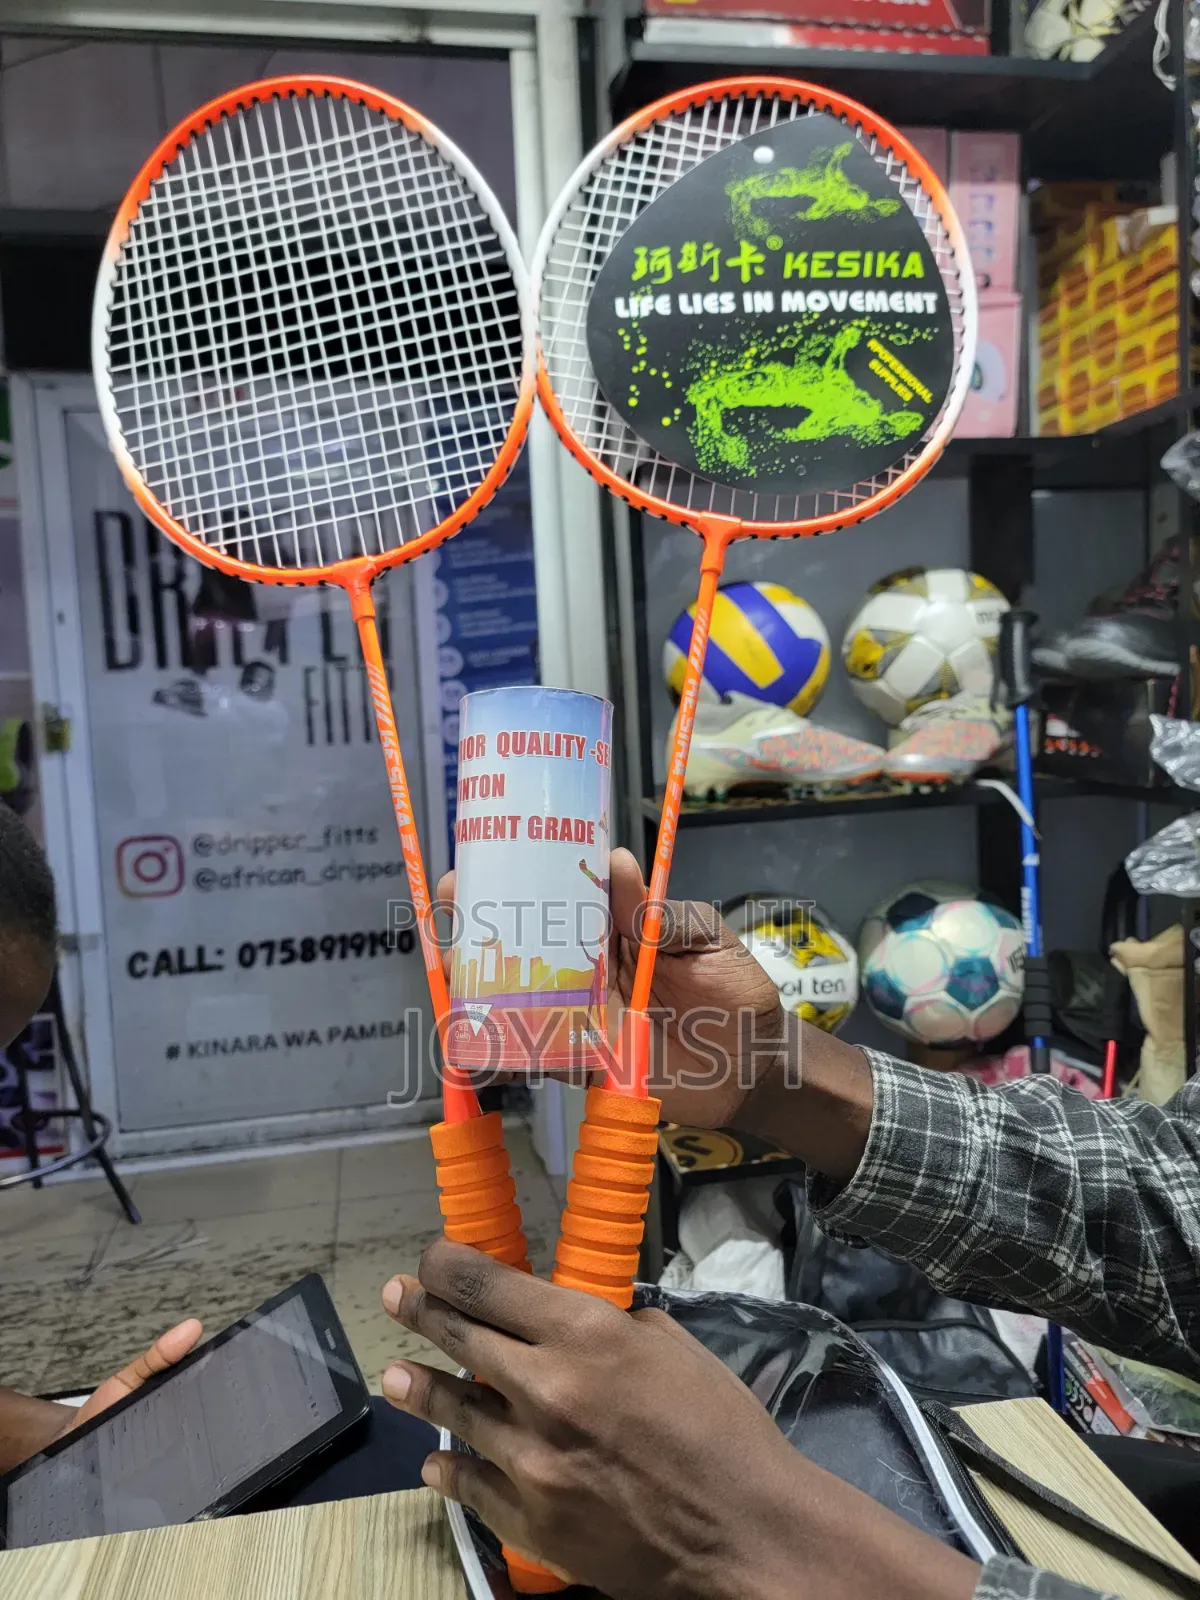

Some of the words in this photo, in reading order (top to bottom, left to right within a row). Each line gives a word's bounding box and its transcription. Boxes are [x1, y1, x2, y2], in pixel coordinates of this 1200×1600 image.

[782, 250, 925, 279] KESIKA
[614, 293, 672, 319] LIFE
[678, 291, 737, 315] LIES
[742, 290, 775, 314] IN
[780, 289, 939, 315] MOVEMENT
[459, 733, 487, 762] IOR
[496, 731, 587, 760] QUALITY
[527, 815, 596, 846] GRADE
[127, 945, 225, 980] CALL:
[237, 928, 416, 970] 0758919190
[187, 1033, 278, 1060] KINARA
[283, 1028, 322, 1051] WA
[326, 1019, 410, 1044] PAMBA
